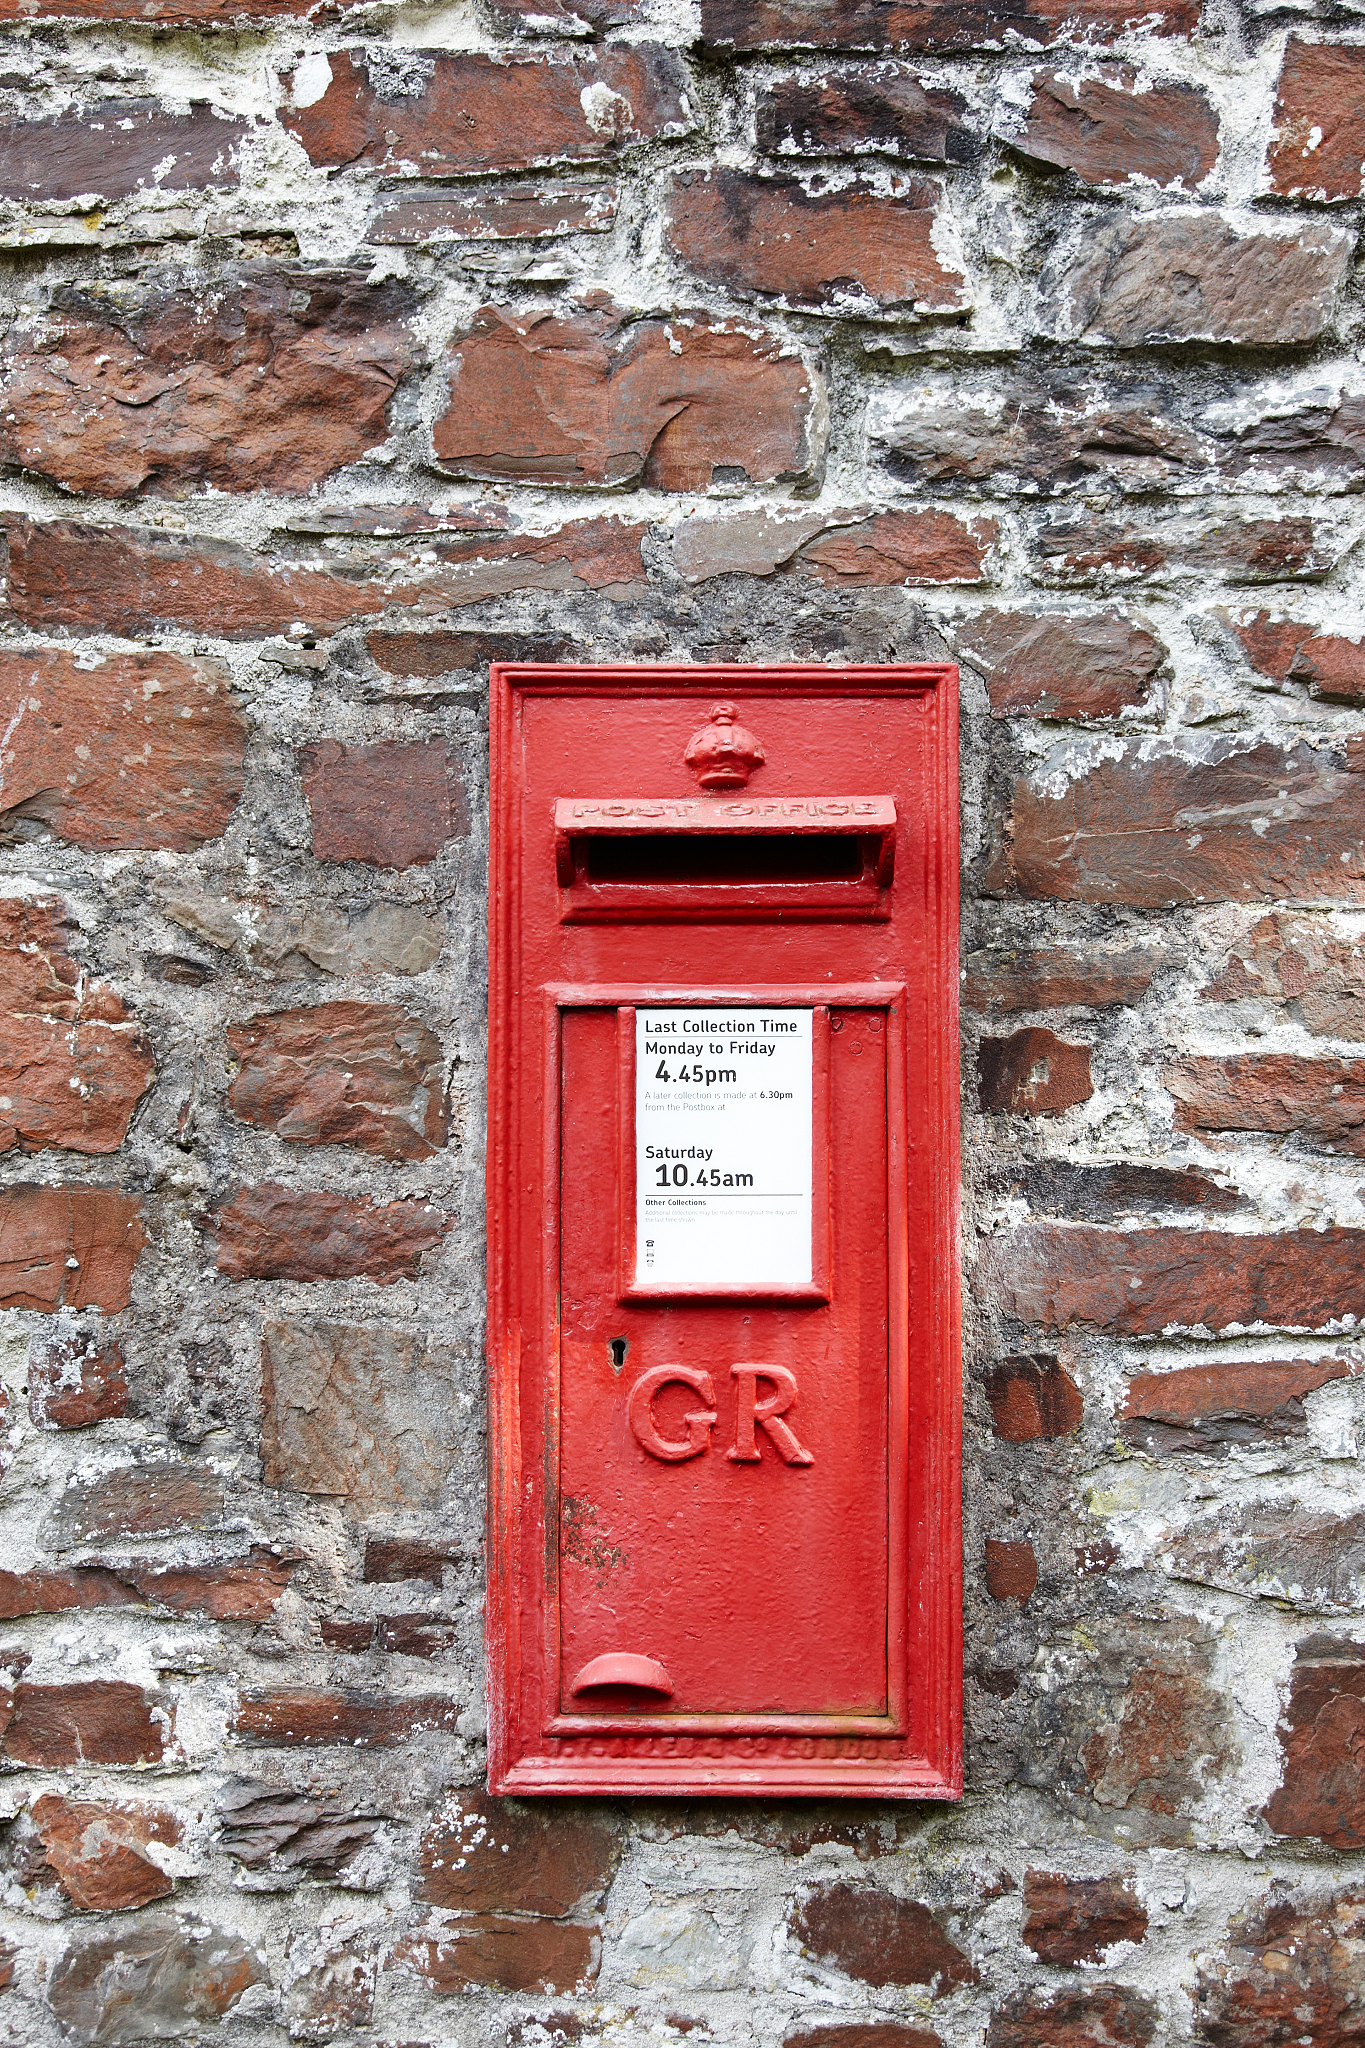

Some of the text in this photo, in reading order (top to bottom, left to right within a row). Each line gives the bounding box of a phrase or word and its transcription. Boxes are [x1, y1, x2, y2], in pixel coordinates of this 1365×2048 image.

[573, 801, 881, 819] POST OFFICE
[645, 1019, 798, 1033] Last Collection Time
[645, 1041, 776, 1058] Monday to Friday
[655, 1059, 737, 1087] 4.45pm
[645, 1090, 794, 1101] A later collection is made at 6.30pm
[645, 1103, 726, 1112] from the Postbox at
[645, 1145, 714, 1162] Saturday
[655, 1163, 754, 1187] 10.45am
[628, 1363, 815, 1466] GR
